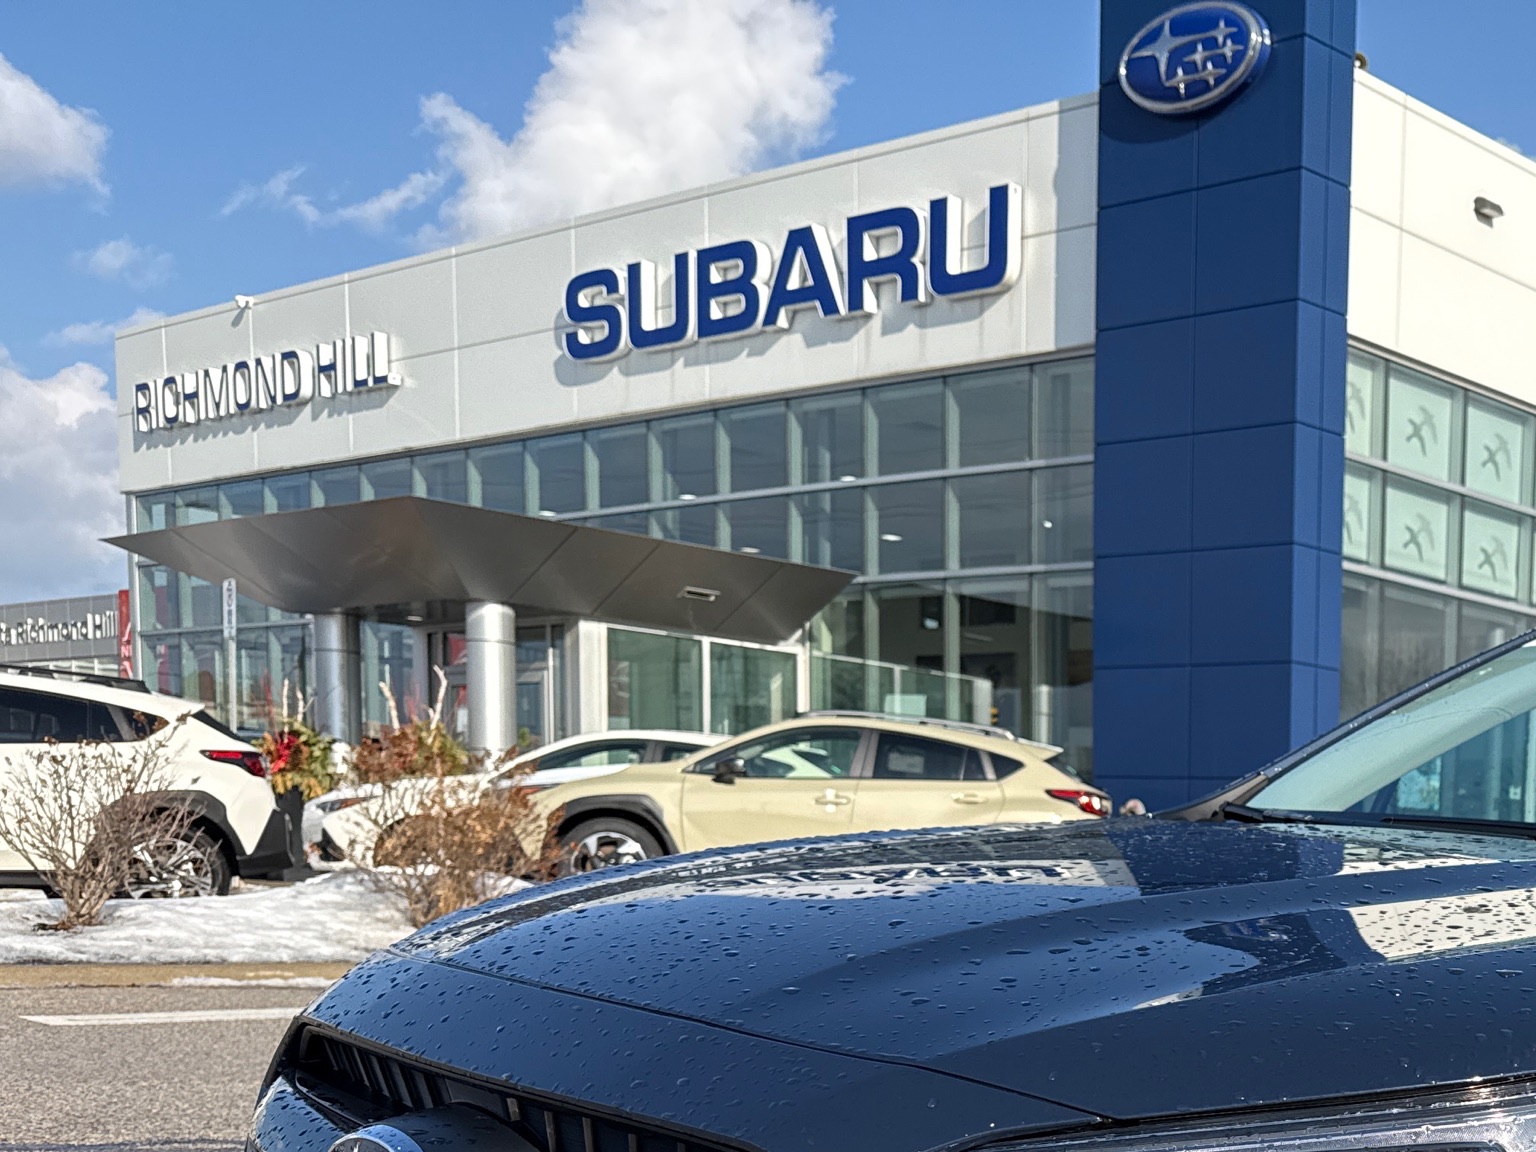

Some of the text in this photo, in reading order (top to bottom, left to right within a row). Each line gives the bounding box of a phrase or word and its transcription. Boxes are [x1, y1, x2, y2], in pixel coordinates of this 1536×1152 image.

[564, 184, 1018, 361] SUBARU
[134, 331, 400, 431] RICHMOND HILL
[17, 613, 93, 645] Richmond
[94, 610, 118, 639] Hill
